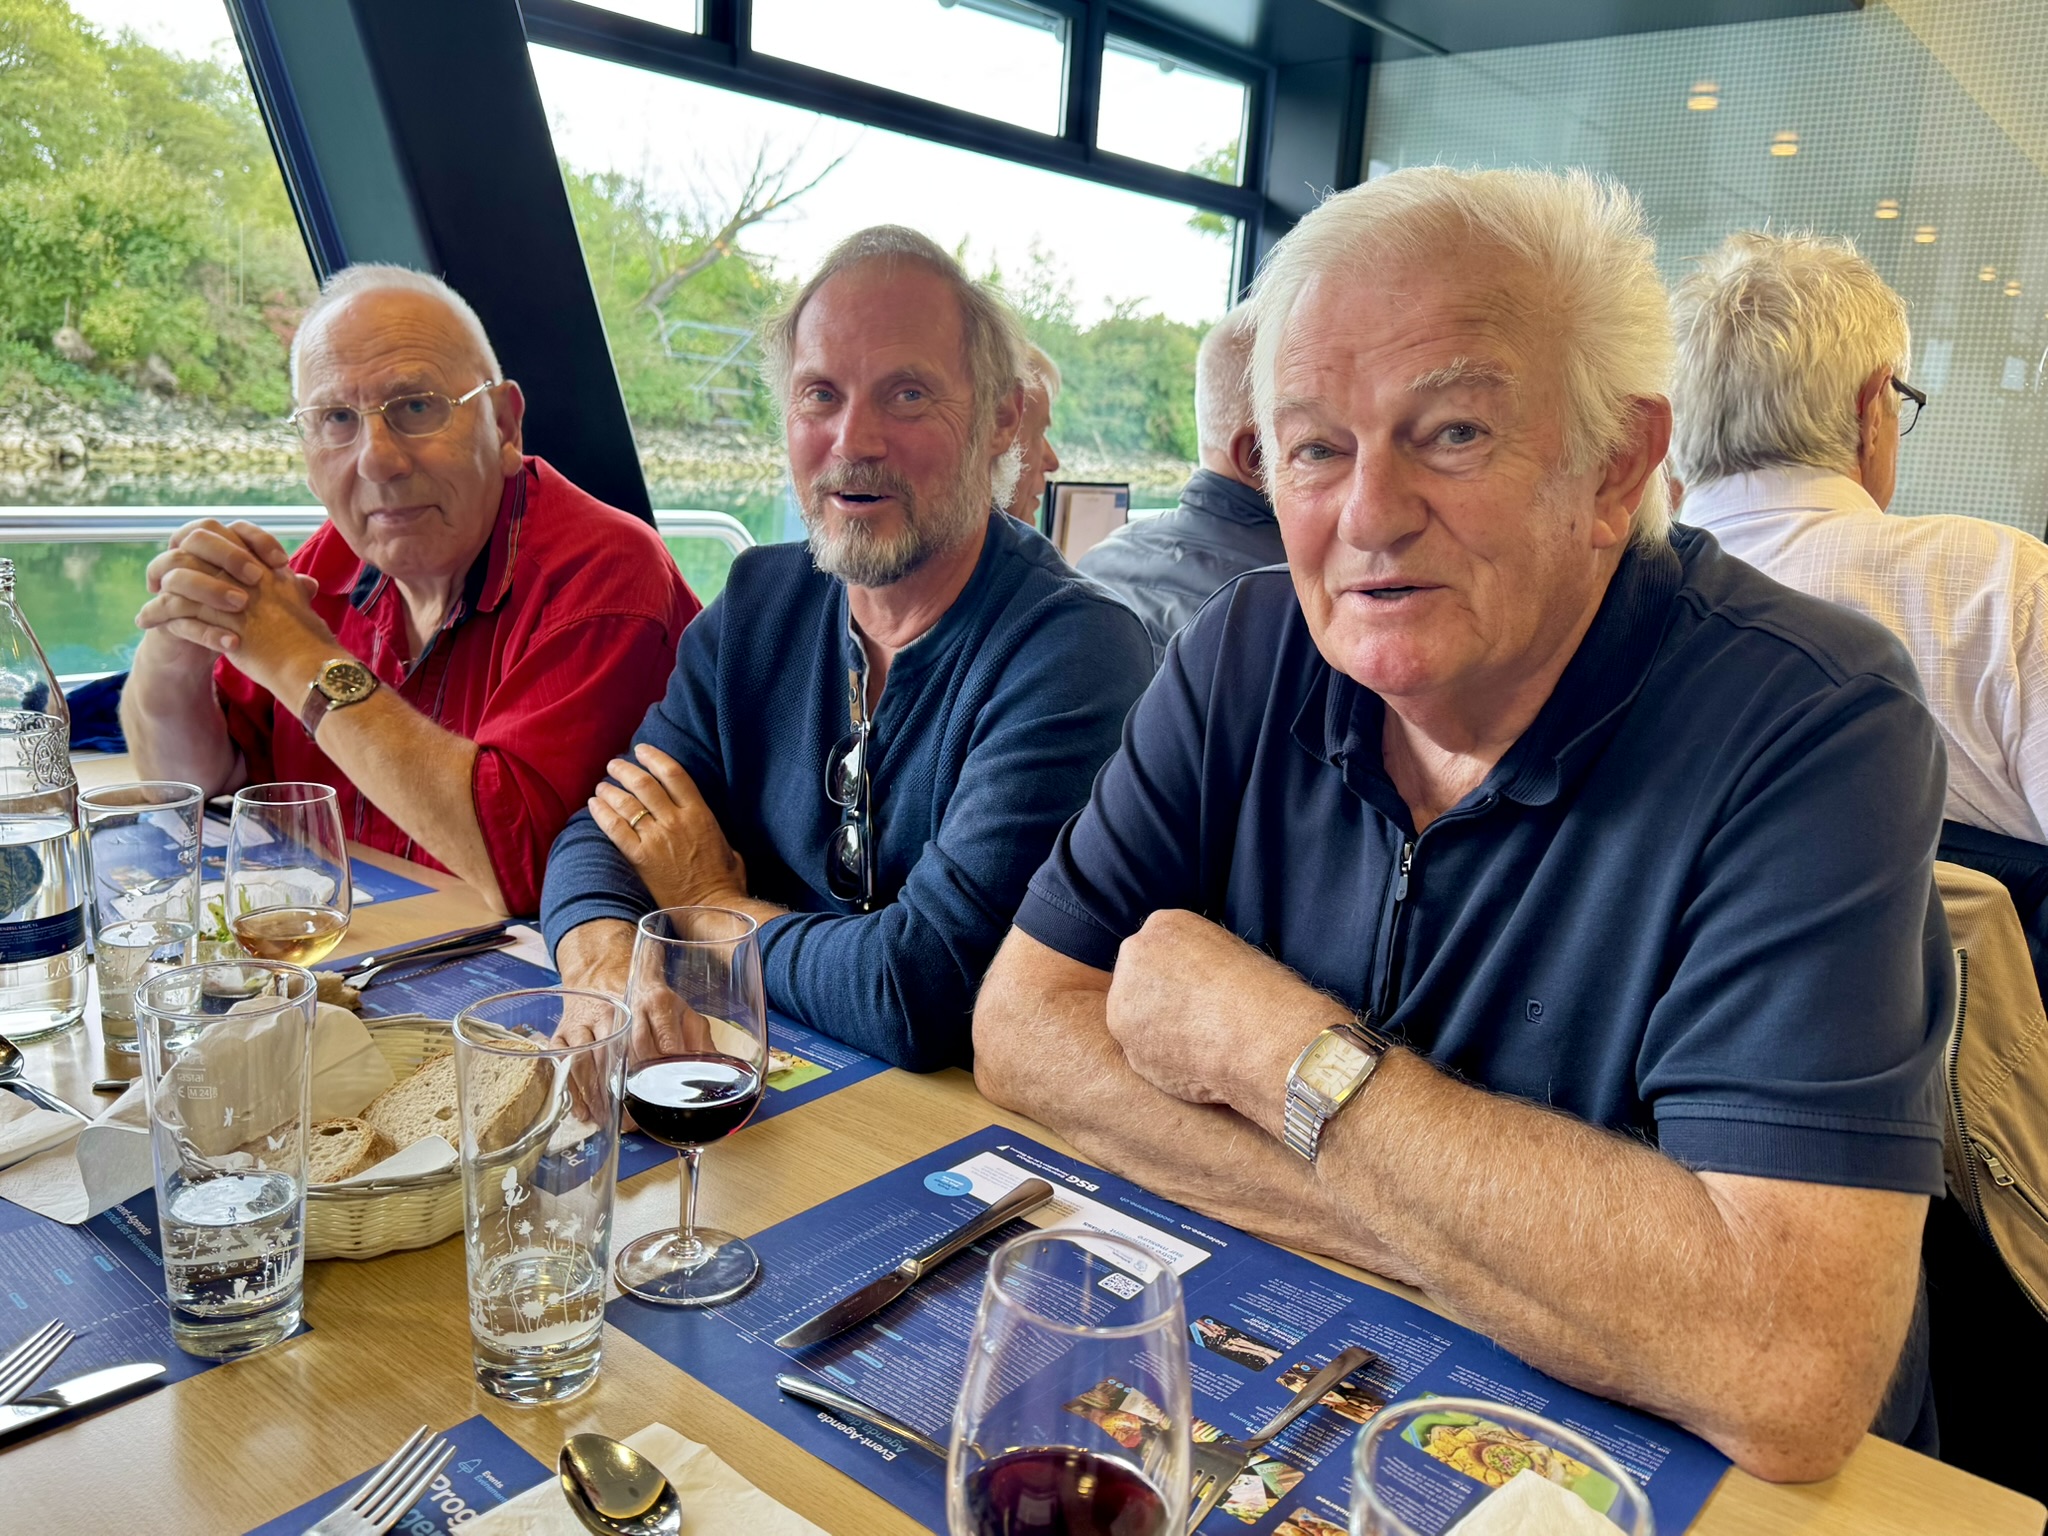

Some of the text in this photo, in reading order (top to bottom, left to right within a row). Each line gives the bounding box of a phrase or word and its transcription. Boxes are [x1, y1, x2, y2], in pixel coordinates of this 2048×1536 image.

[199, 1088, 210, 1097] 24
[1063, 1175, 1100, 1191] BSG
[104, 1210, 122, 1225] enda
[114, 1203, 152, 1236] vent-Agenda
[1178, 1223, 1229, 1246] bielersee.ch
[812, 1411, 899, 1461] Event-Agenda
[857, 1423, 909, 1453] Agenda
[482, 1470, 504, 1489] Events
[430, 1474, 481, 1528] Prog
